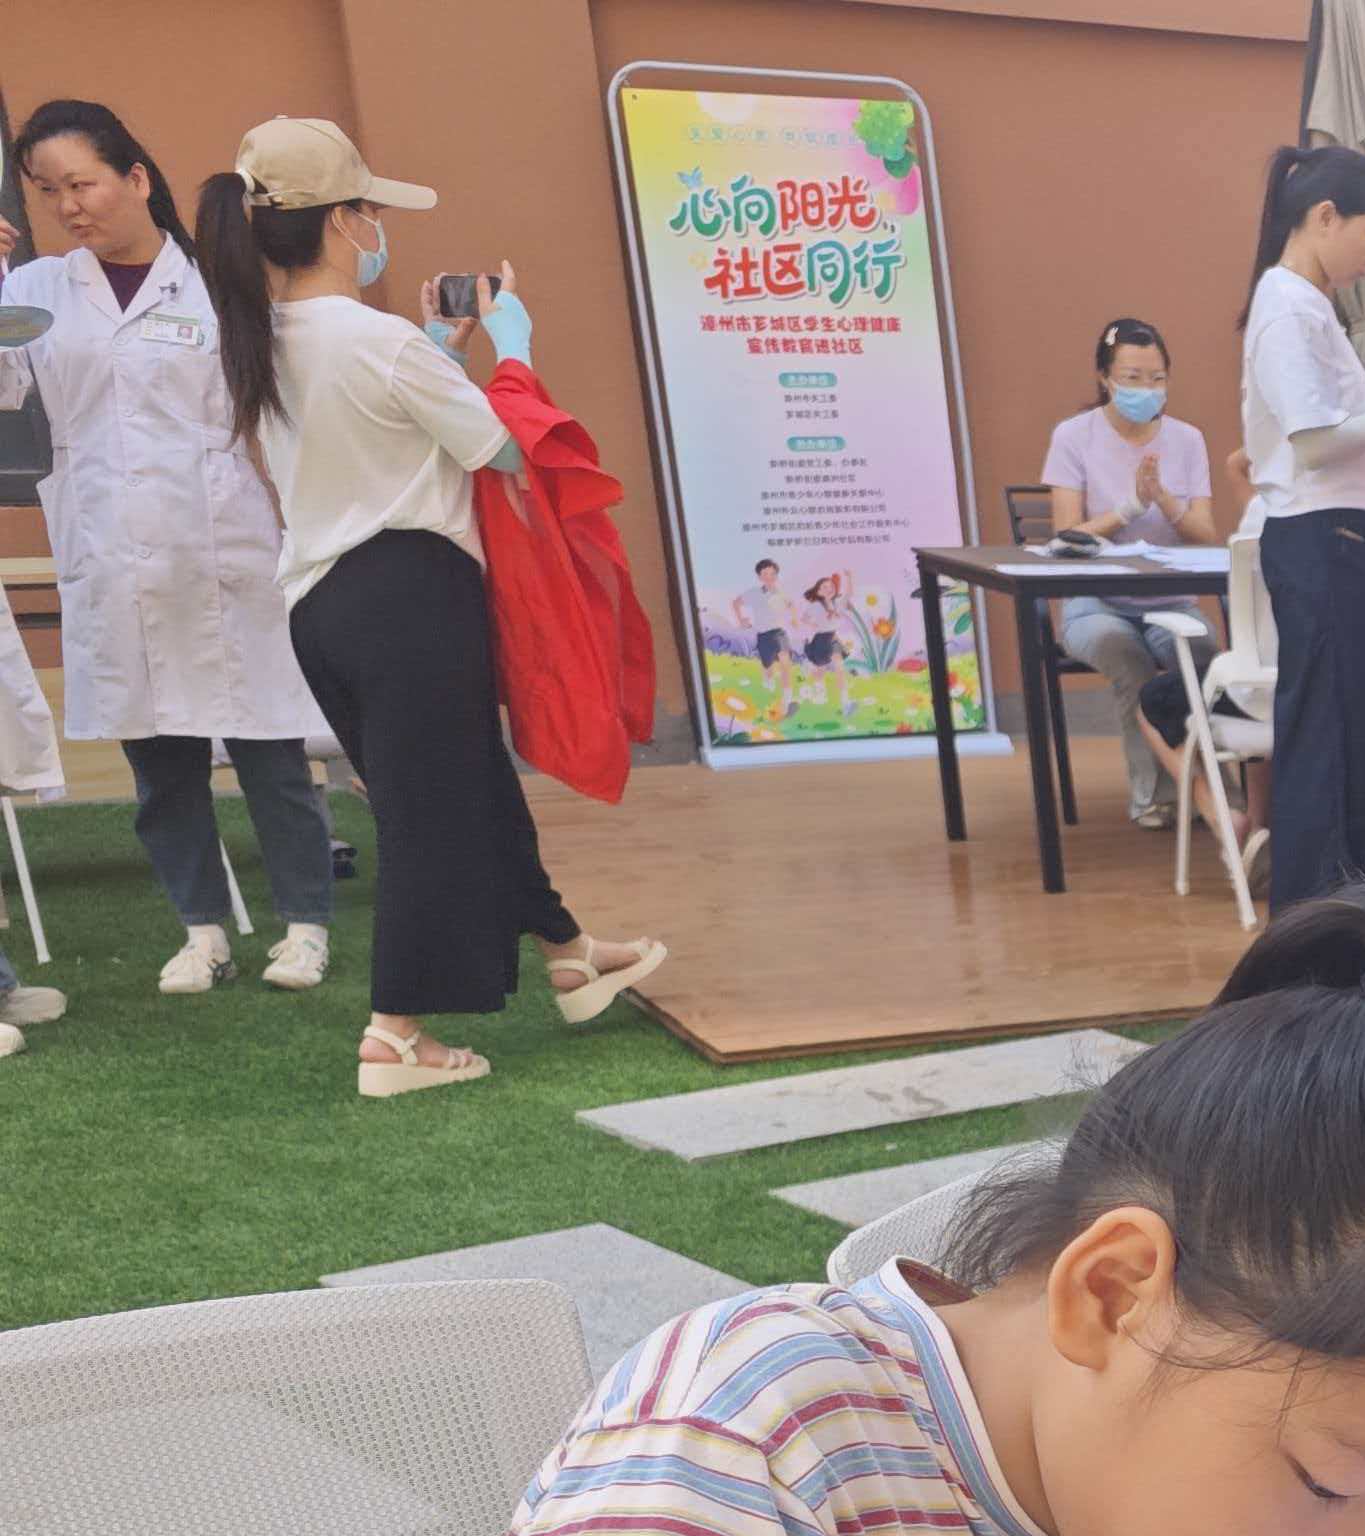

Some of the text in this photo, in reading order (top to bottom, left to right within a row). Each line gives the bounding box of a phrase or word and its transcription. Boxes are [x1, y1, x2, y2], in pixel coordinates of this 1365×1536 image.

[668, 175, 877, 237] 心向阳光
[703, 239, 904, 305] 社区同行
[746, 338, 865, 355] 宣传教育进社区
